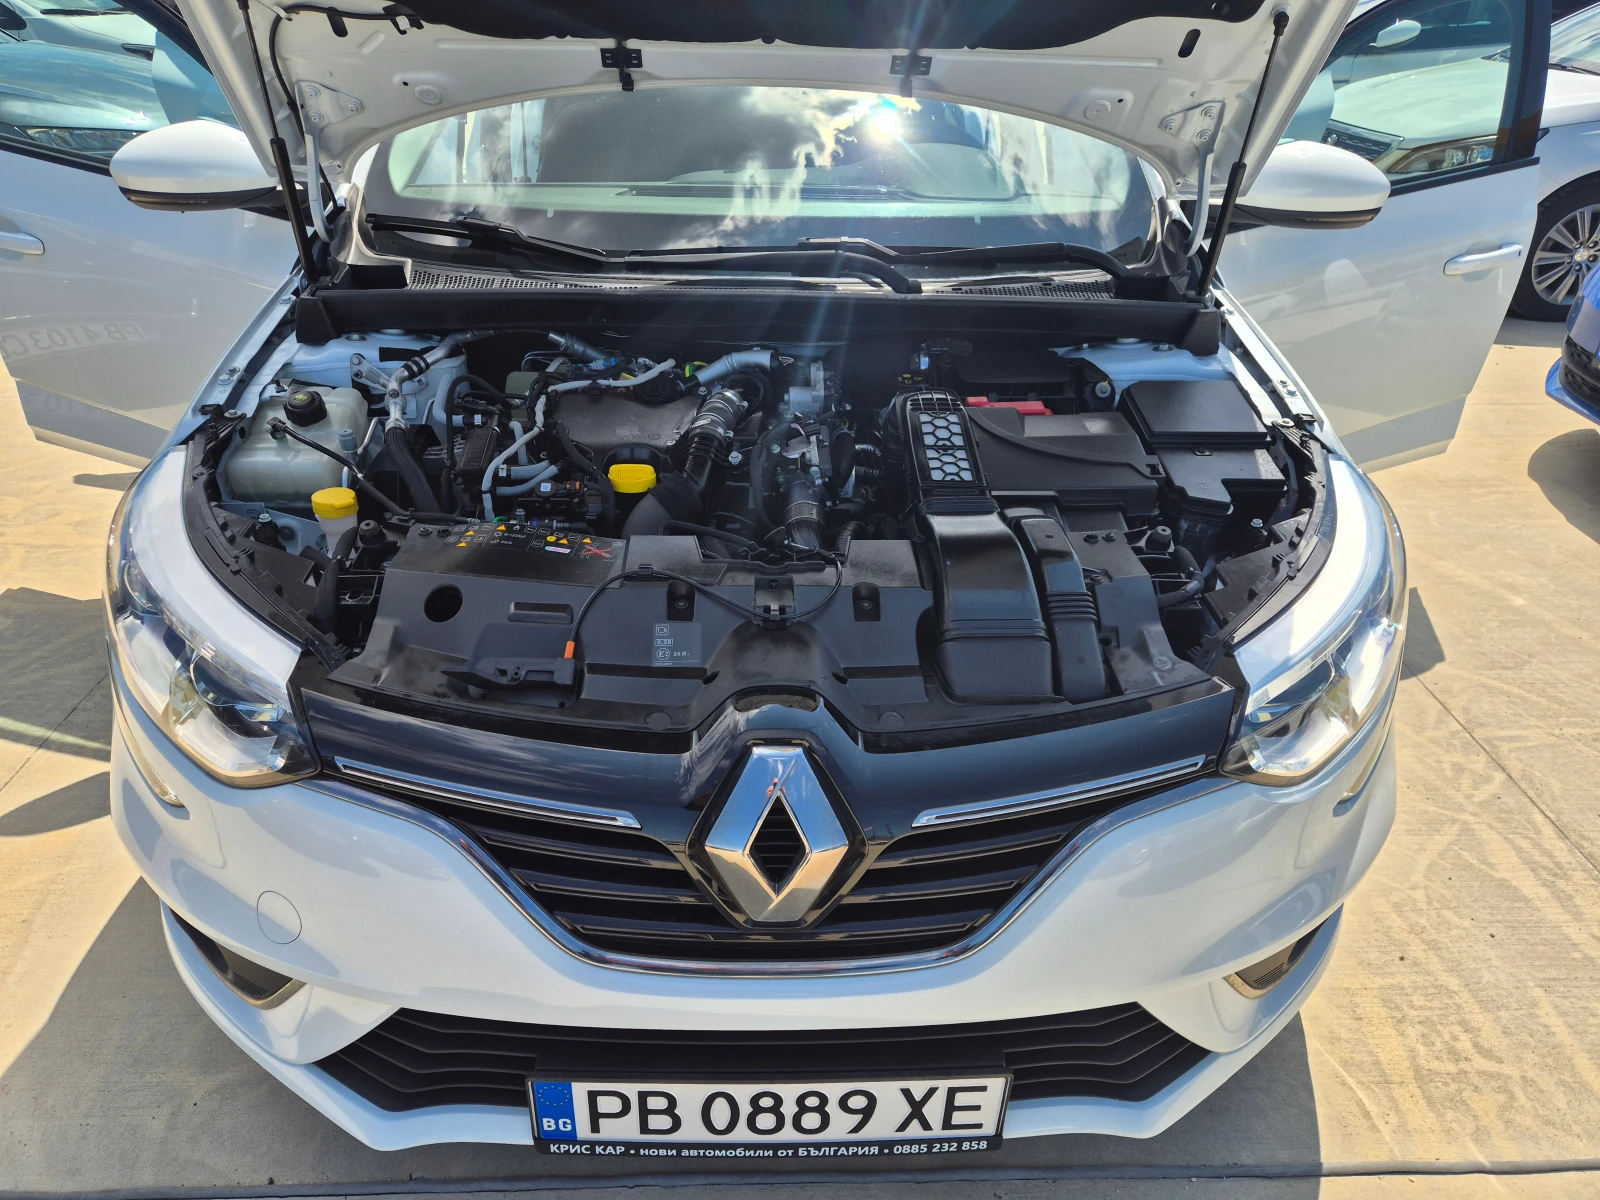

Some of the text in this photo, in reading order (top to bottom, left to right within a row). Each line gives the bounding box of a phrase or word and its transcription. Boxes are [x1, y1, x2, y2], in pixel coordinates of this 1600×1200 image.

[542, 1085, 988, 1136] BG PB 0889 XE
[549, 1143, 591, 1154] КРИС
[595, 1145, 625, 1155] КАР
[640, 1148, 677, 1156] нови
[681, 1147, 773, 1157] автомобили
[798, 1146, 879, 1156] БЪЛГАРИЯ
[893, 1143, 928, 1154] 0885
[931, 1142, 958, 1152] 232
[961, 1140, 988, 1150] 858
